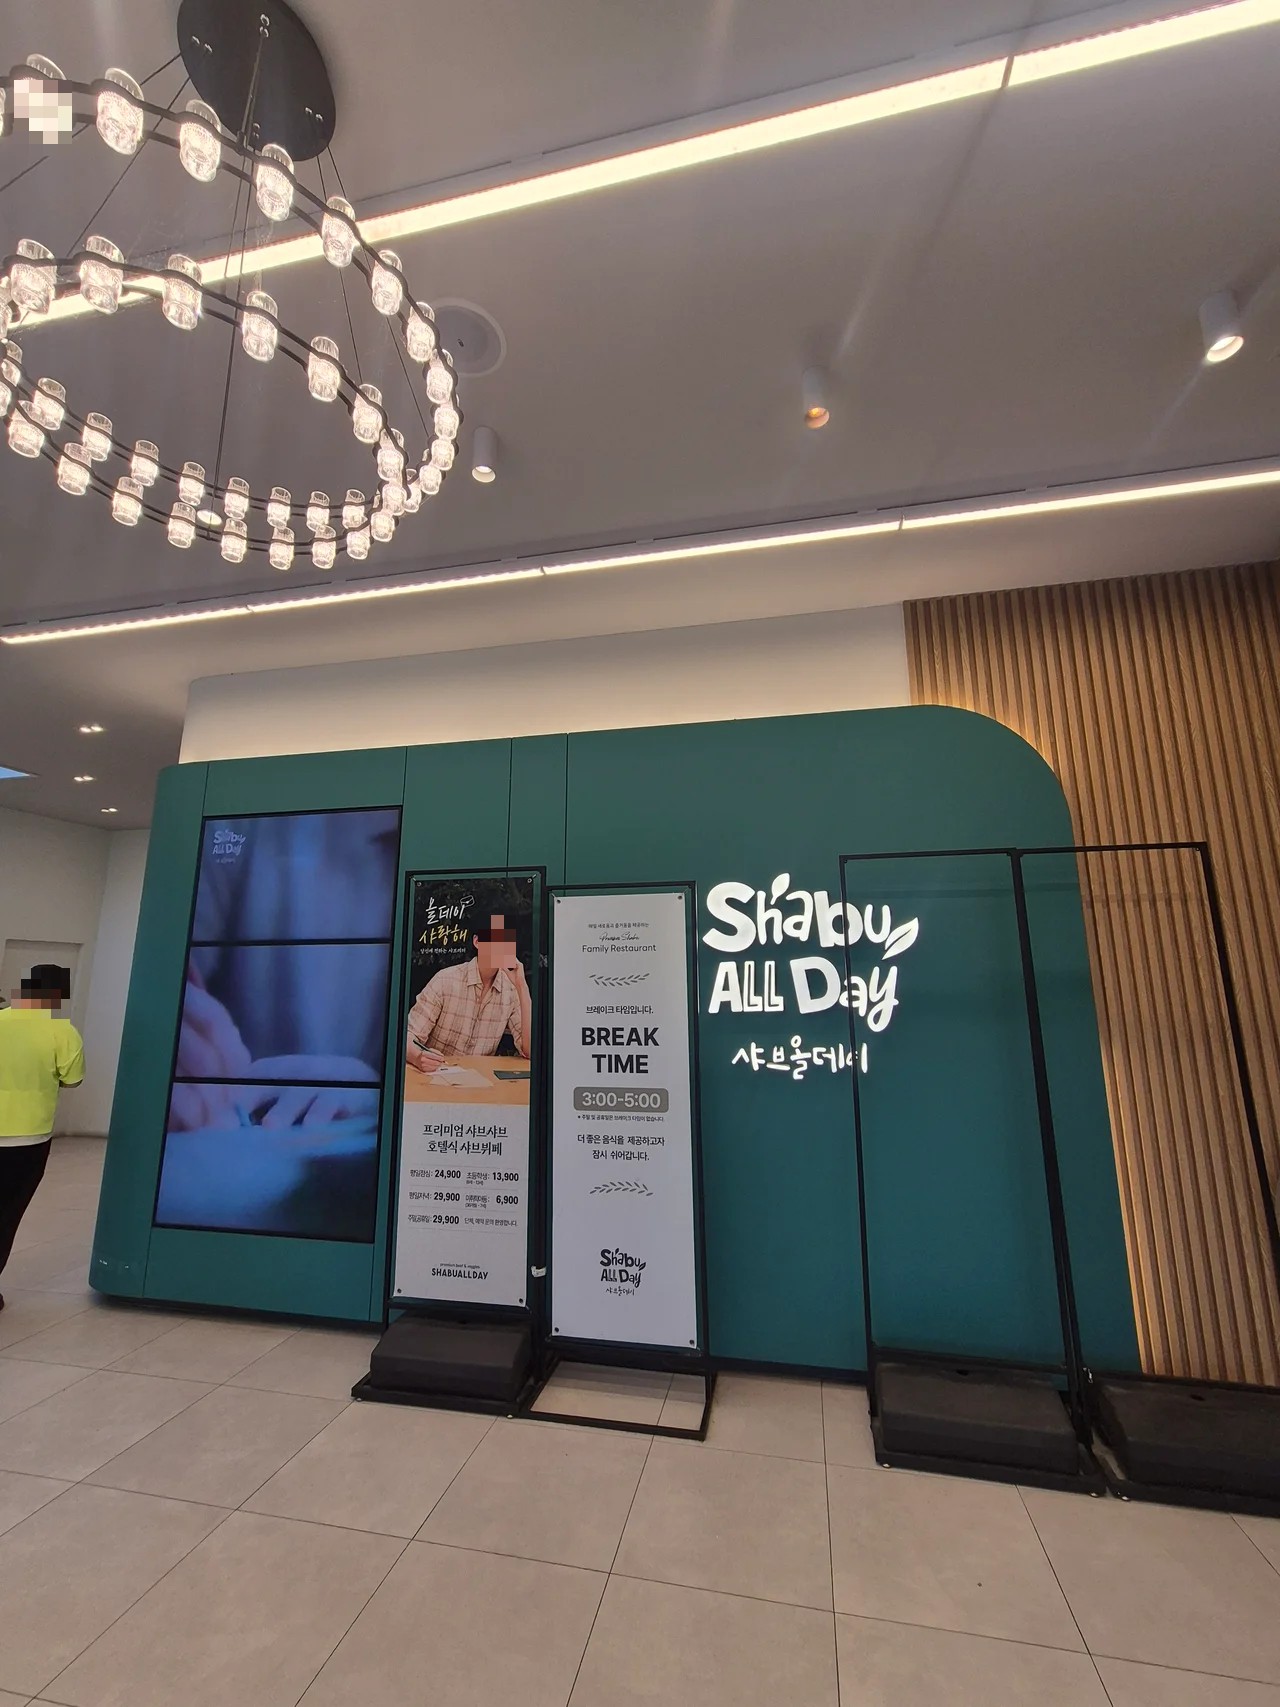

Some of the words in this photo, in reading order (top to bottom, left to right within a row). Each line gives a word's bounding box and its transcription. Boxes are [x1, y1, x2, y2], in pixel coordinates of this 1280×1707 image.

[702, 874, 912, 954] Shabu
[582, 944, 609, 954] Family
[610, 944, 657, 952] Restaurant
[708, 960, 784, 1014] ALL
[789, 956, 899, 1032] Day
[586, 1005, 615, 1014] 브레이크
[615, 1005, 654, 1015] 타임입니다.
[581, 1027, 660, 1046] BREAK
[591, 1054, 649, 1074] TIME
[582, 1092, 661, 1109] 3:00-5:00
[422, 1124, 464, 1138] 프리미엄
[465, 1125, 508, 1138] 샤브샤브
[577, 1134, 585, 1143] 더
[586, 1134, 601, 1145] 좋은
[602, 1135, 624, 1145] 음식을
[627, 1136, 665, 1146] 제공하고자
[427, 1140, 458, 1154] 호텔식
[459, 1141, 502, 1156] 샤브뷔페
[592, 1150, 607, 1160] 잠시
[610, 1151, 650, 1161] 쉬어갑니다.
[434, 1169, 461, 1179] 24,900
[492, 1172, 519, 1182] 13,900
[433, 1192, 460, 1202] 29,900
[496, 1195, 519, 1205] 6,900
[432, 1214, 459, 1225] 29,900
[600, 1248, 646, 1270] Shabu
[431, 1268, 488, 1280] SHABUALLDAY
[618, 1269, 641, 1288] Day
